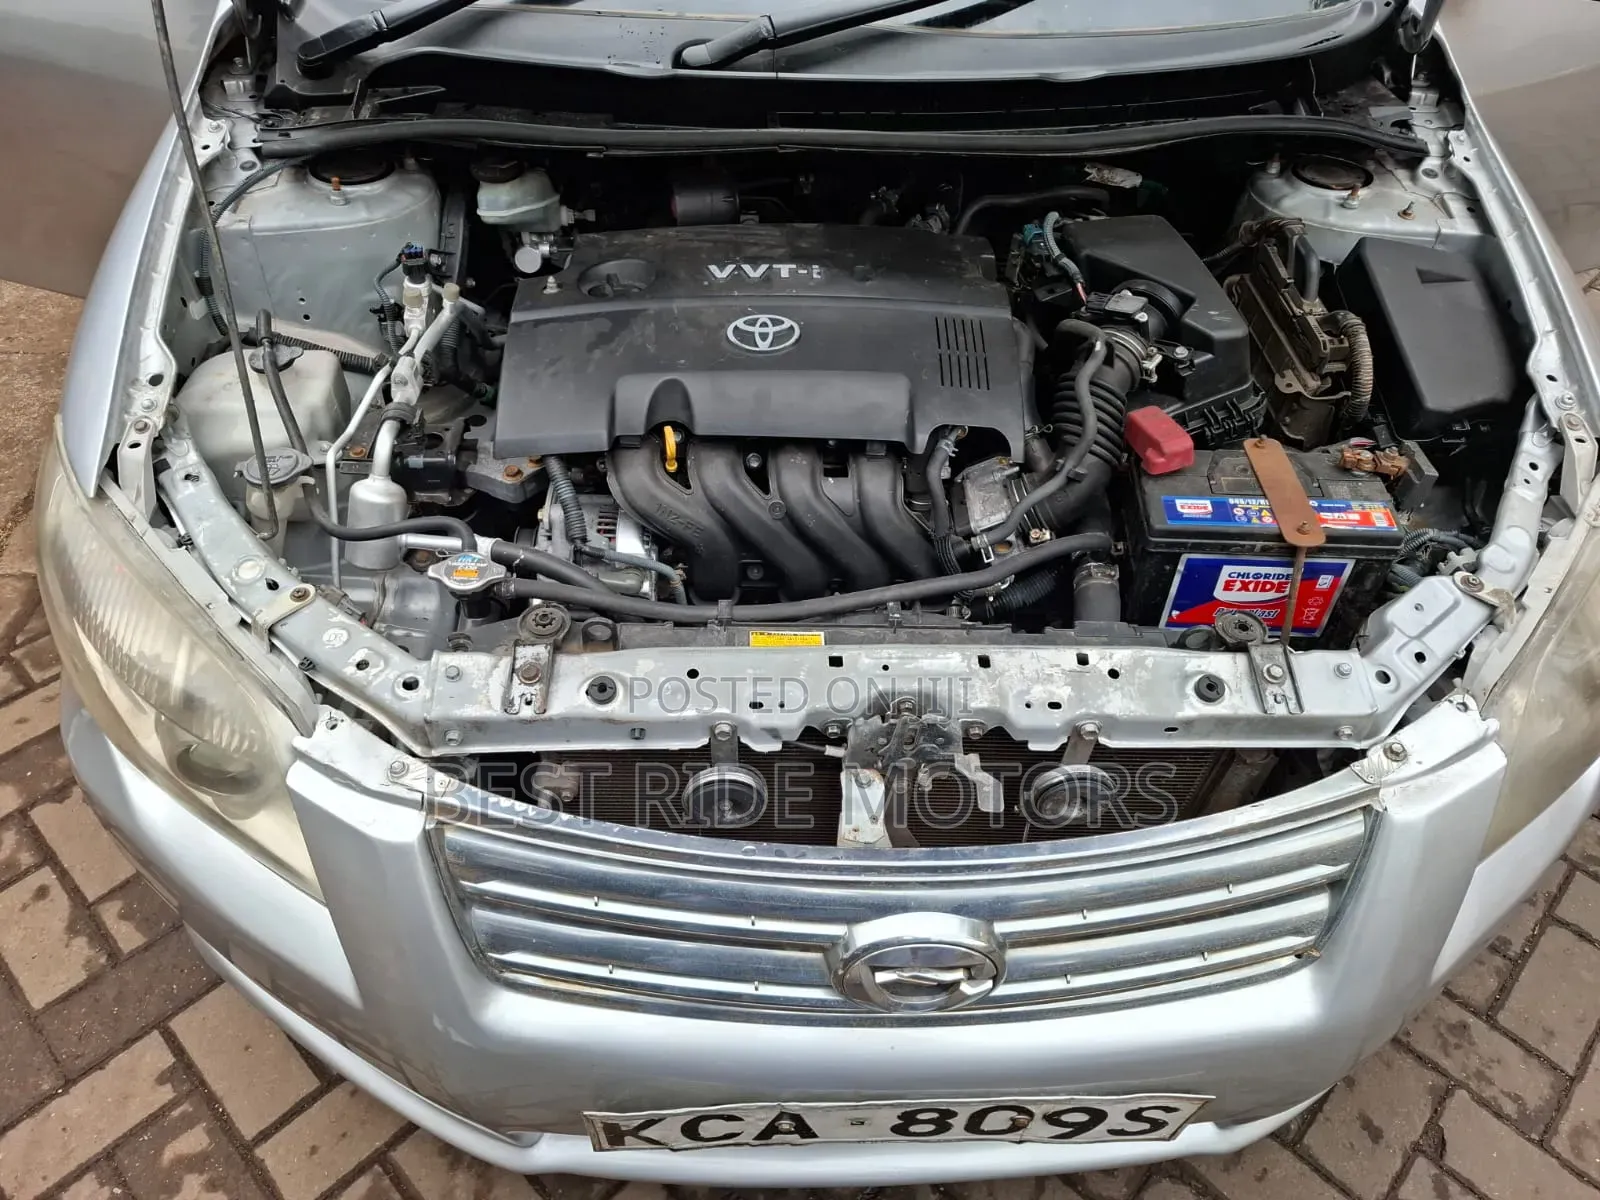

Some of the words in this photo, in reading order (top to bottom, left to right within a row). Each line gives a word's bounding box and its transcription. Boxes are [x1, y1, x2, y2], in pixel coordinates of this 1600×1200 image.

[707, 263, 822, 279] VVT-i
[1227, 571, 1293, 581] CHLORIDE
[1222, 578, 1291, 593] EXIDE
[602, 1110, 819, 1147] KCA
[890, 1104, 1180, 1139] 809S
